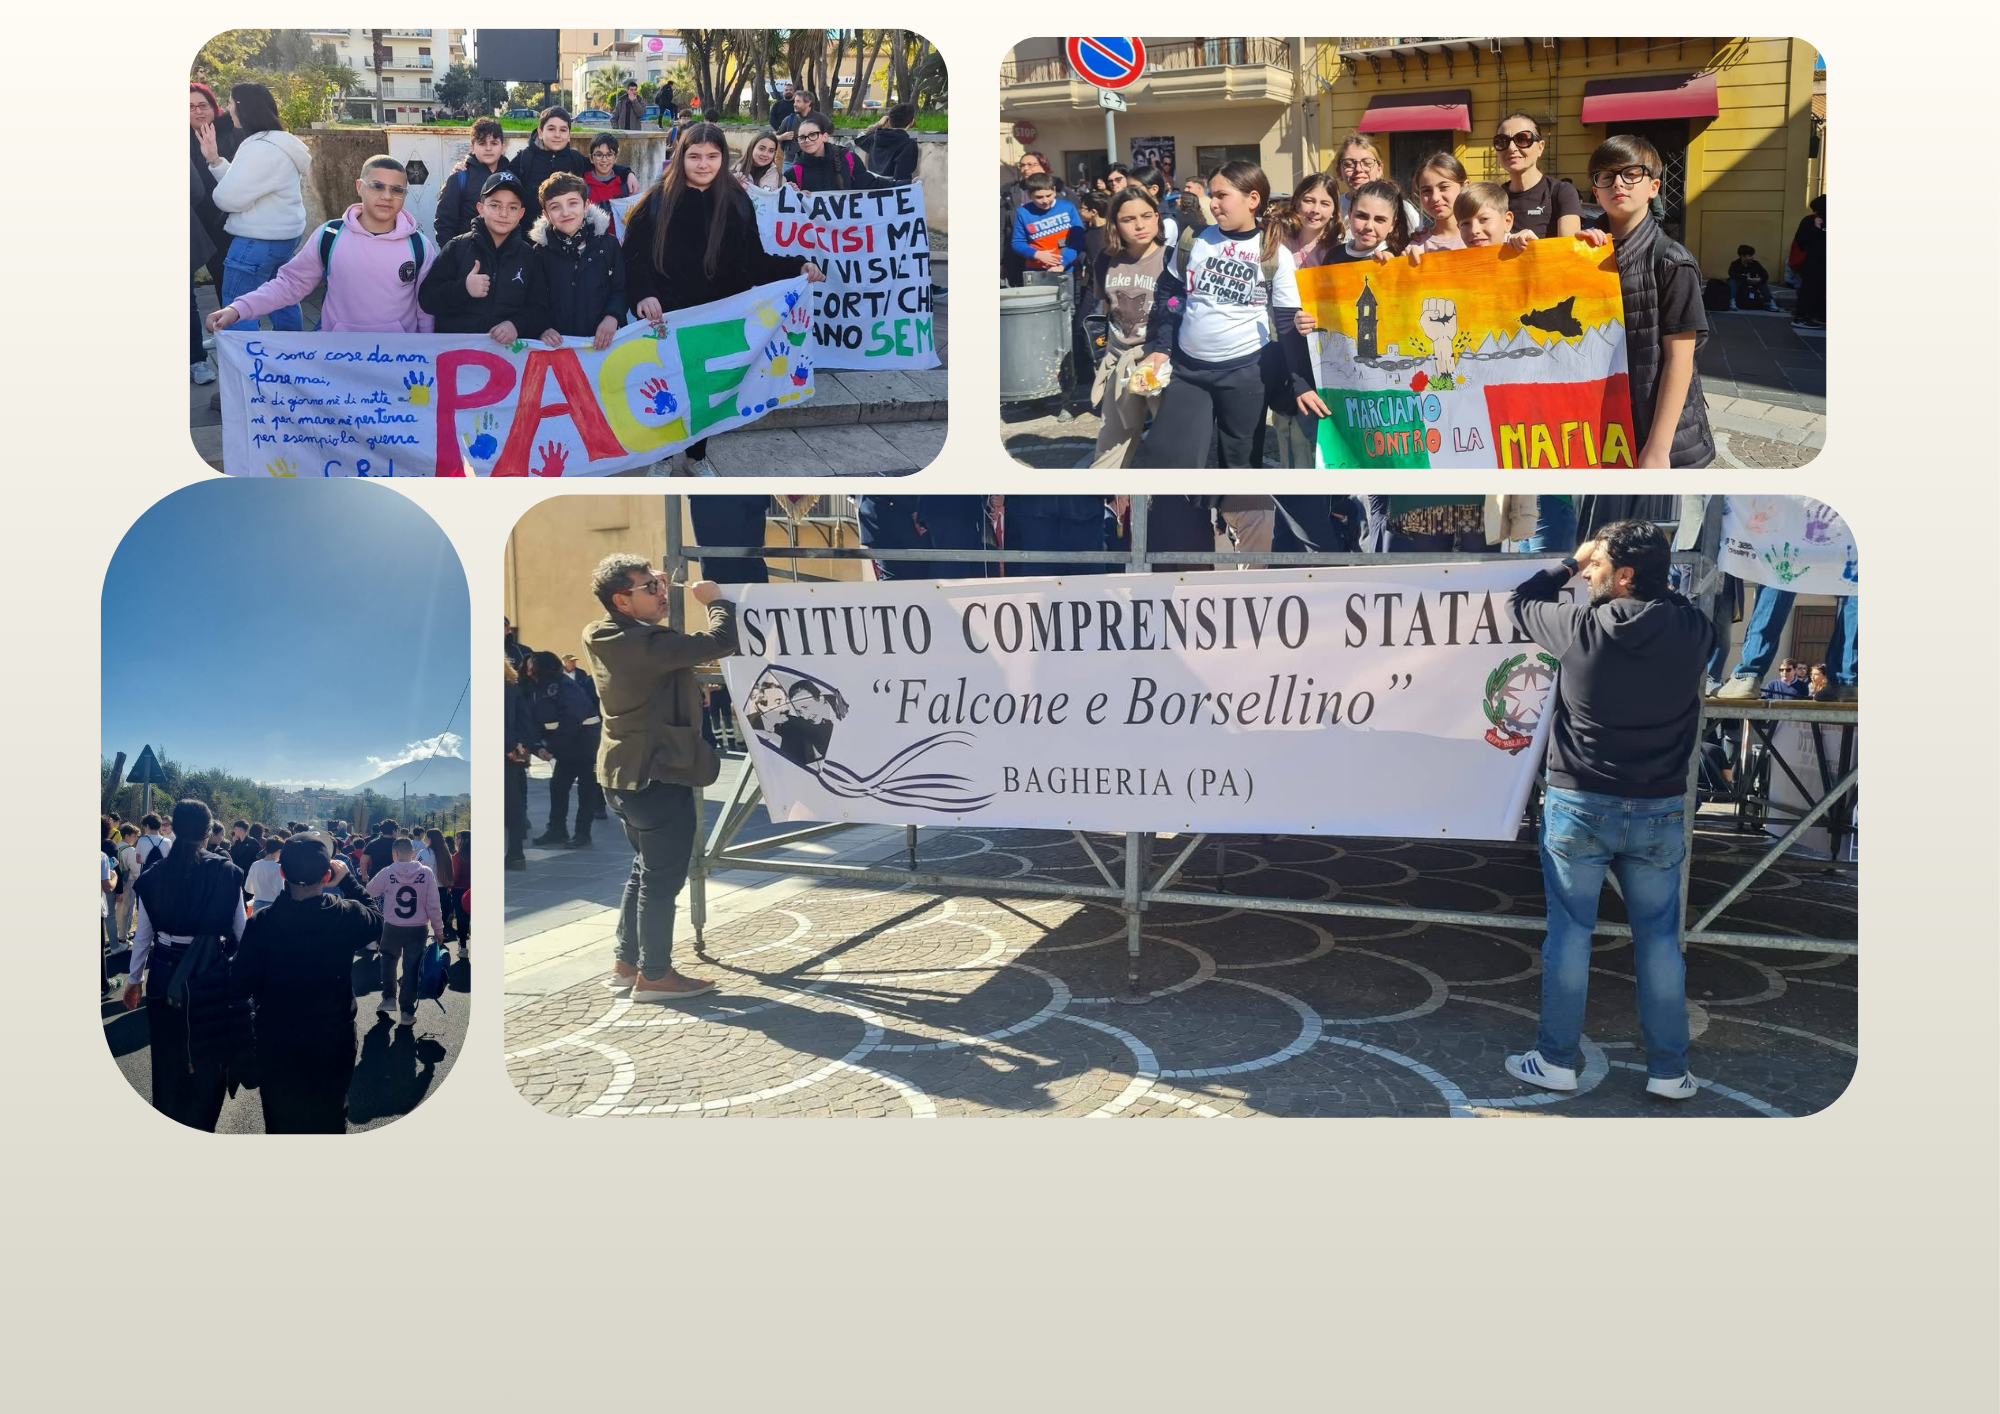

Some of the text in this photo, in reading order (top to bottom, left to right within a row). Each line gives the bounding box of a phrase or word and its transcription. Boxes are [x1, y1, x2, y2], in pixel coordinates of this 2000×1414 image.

[1014, 126, 1037, 138] STOP
[808, 188, 915, 222] AVETE
[775, 217, 929, 253] UCCISI MA
[835, 260, 862, 284] VI
[1205, 256, 1254, 281] UCCISO
[1105, 273, 1158, 292] Lake Mills
[1197, 280, 1211, 293] LA
[1212, 285, 1246, 304] TORRE
[1227, 279, 1246, 292] PIO
[246, 341, 269, 357] Ci
[366, 344, 393, 364] da
[396, 352, 429, 364] non
[249, 358, 292, 396] fare
[271, 391, 285, 406] di
[287, 397, 323, 412] giorno
[344, 393, 357, 405] di
[360, 390, 393, 405] notte
[1344, 393, 1442, 430] MARCIAMO
[271, 416, 294, 431] per
[297, 417, 336, 426] mare
[252, 430, 420, 450] per esempio la guerra
[1364, 420, 1634, 469] CONTRO LA MAFIA
[962, 594, 1310, 655] COMPRENSIVO
[1085, 692, 1108, 725] e
[1003, 766, 1255, 804] BAGHERIA (PA)
[394, 885, 418, 919] 9
